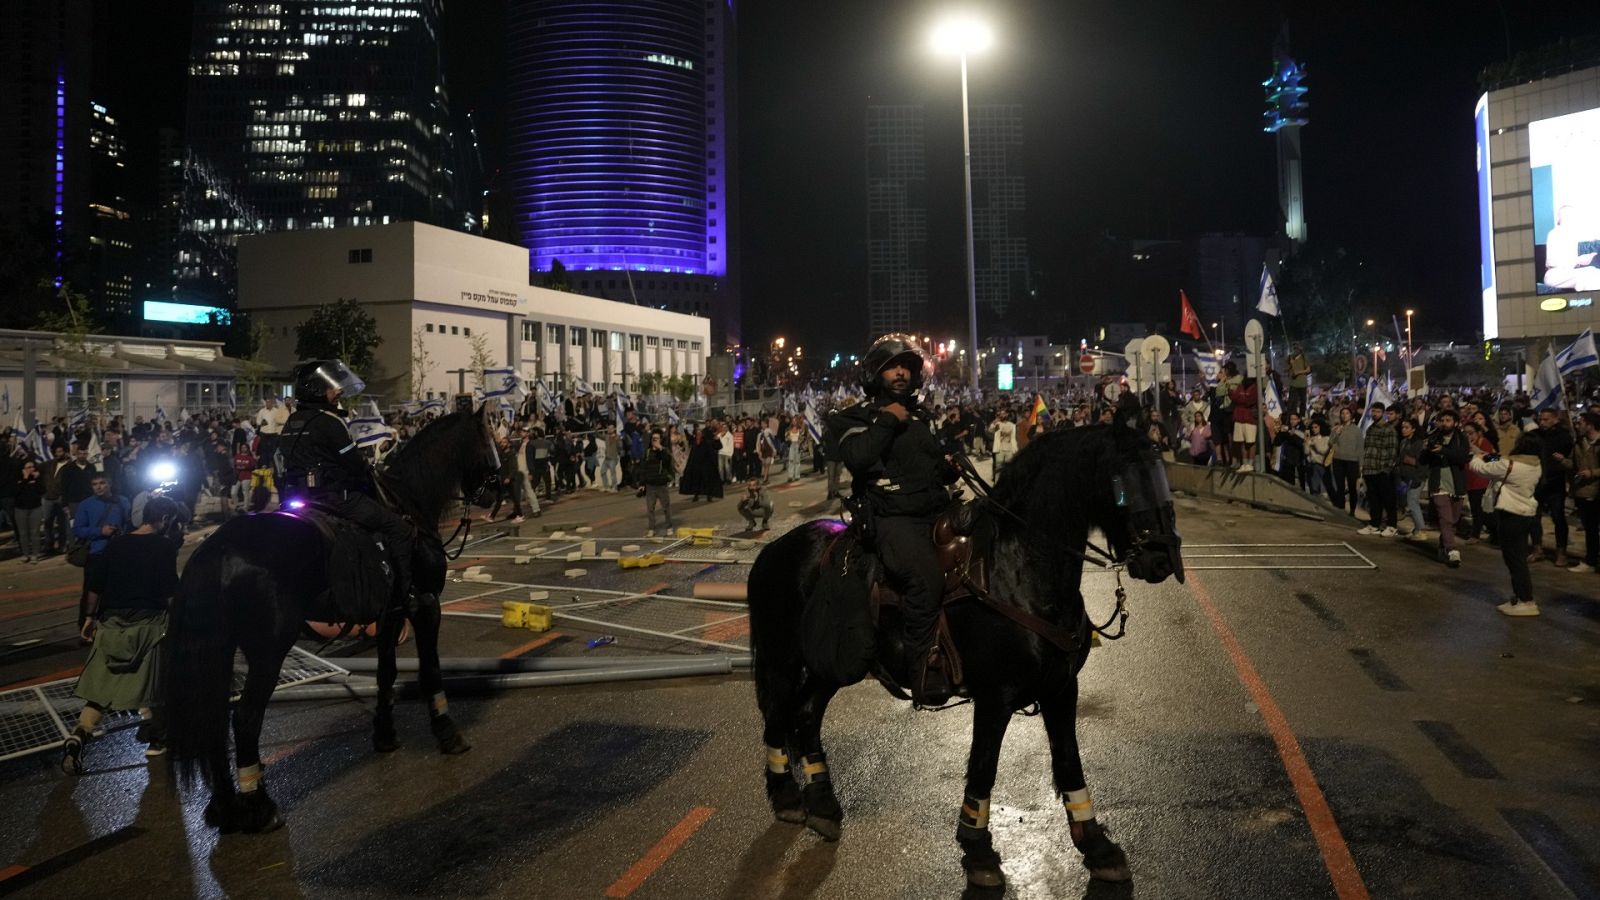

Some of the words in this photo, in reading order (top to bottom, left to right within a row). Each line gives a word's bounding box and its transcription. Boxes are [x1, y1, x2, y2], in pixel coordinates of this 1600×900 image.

[461, 291, 472, 301] פיין
[473, 293, 486, 302] מקס
[487, 294, 499, 304] עמל
[500, 297, 517, 307] קמפוס
